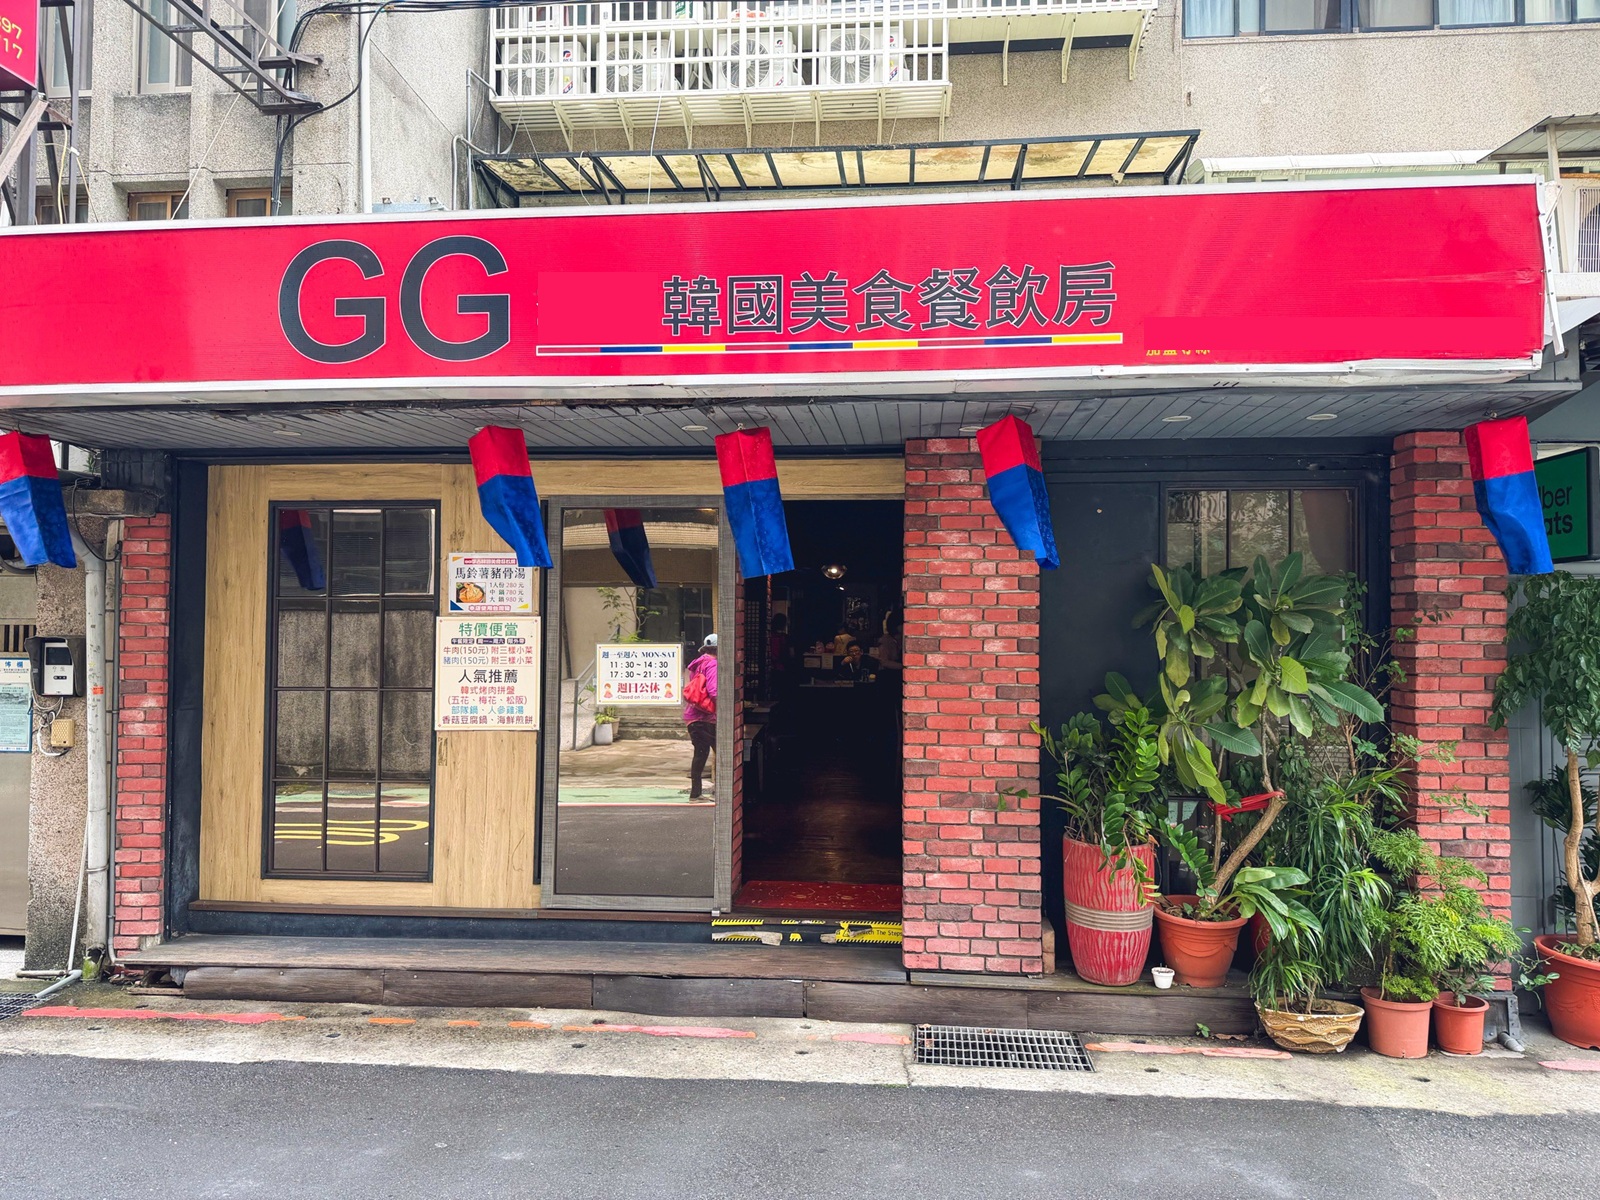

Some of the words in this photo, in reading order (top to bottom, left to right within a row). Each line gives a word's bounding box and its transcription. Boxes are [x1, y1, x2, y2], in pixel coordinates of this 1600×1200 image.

[0, 15, 22, 40] 97
[0, 34, 22, 59] 17
[277, 235, 511, 364] GG
[661, 260, 1118, 336] 韓國美食餐飲房
[1538, 485, 1573, 509] ber
[1544, 511, 1574, 536] ats
[455, 567, 526, 580] 馬鈴薯豬骨湯
[458, 622, 518, 637] 特價便當
[444, 646, 489, 655] 牛肉(150元)
[491, 646, 533, 655] 附三樣小菜
[602, 651, 638, 659] 週一至週六
[444, 656, 489, 665] 豬肉(150元)
[491, 656, 533, 665] 附三樣小菜
[458, 669, 518, 684] 人氣推薦
[460, 686, 515, 695] 韓式烤肉拼盤
[617, 682, 660, 693] 週日公休
